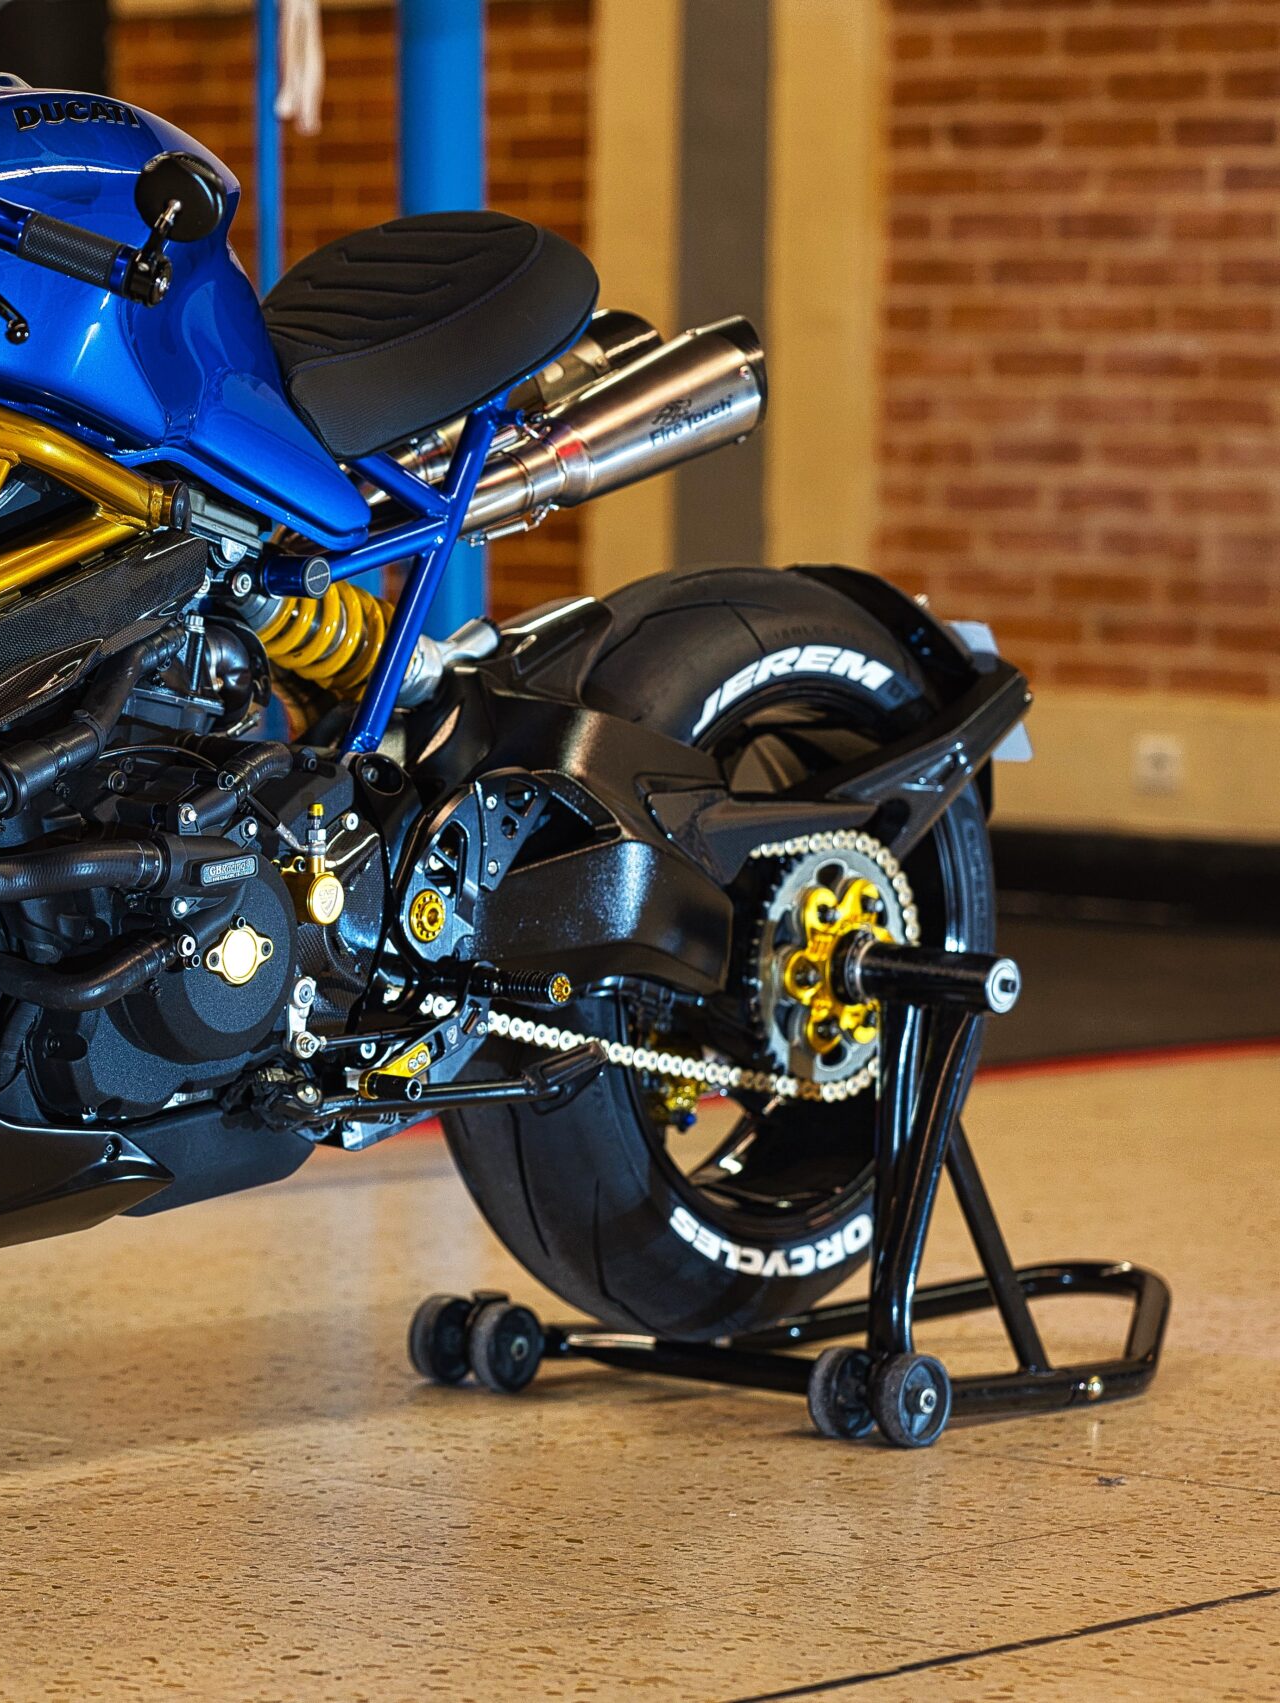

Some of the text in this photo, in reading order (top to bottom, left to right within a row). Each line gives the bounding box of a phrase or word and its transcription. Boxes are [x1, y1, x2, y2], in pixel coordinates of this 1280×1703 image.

[12, 100, 141, 132] DUCATI
[649, 423, 683, 447] Fire
[684, 397, 732, 429] Torch
[692, 644, 895, 738] JEREM
[669, 1205, 874, 1277] ORCYCLES
